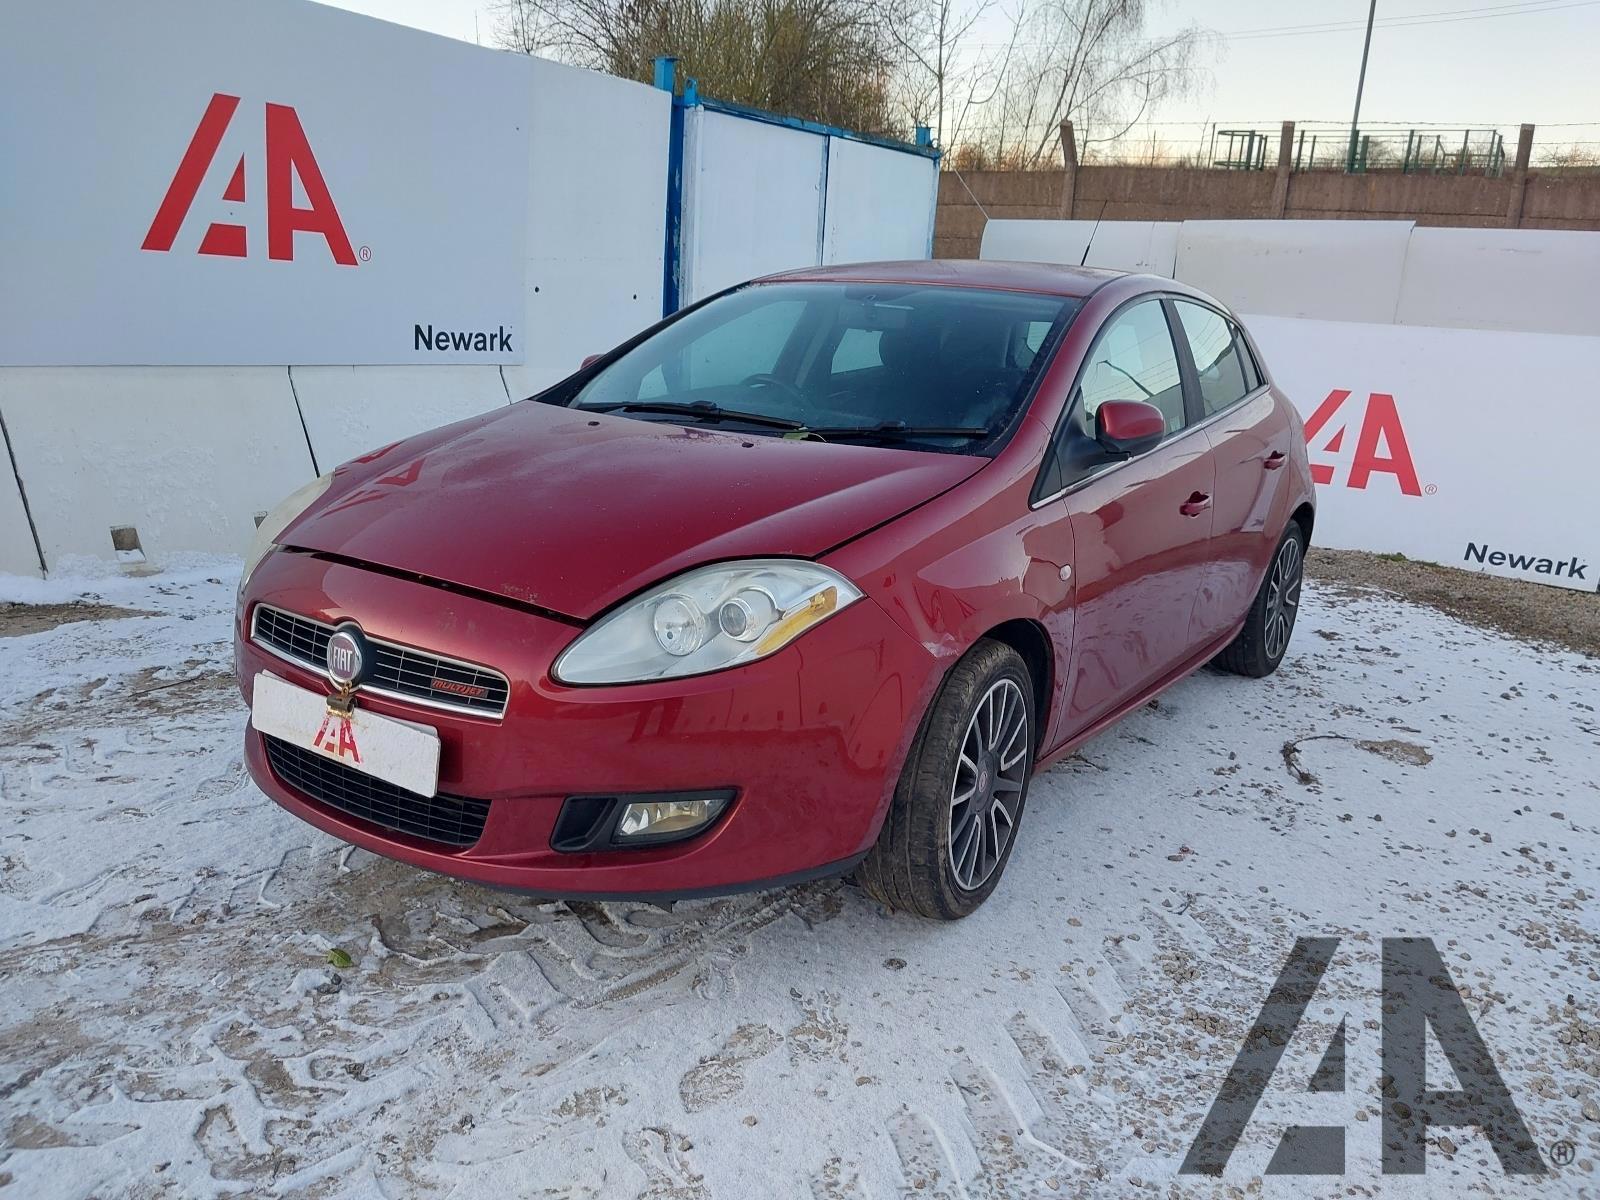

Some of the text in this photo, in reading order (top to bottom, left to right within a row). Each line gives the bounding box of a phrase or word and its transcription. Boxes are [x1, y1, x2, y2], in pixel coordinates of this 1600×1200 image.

[414, 323, 513, 353] Newark
[1463, 542, 1589, 580] Newark
[333, 646, 353, 673] FIAT
